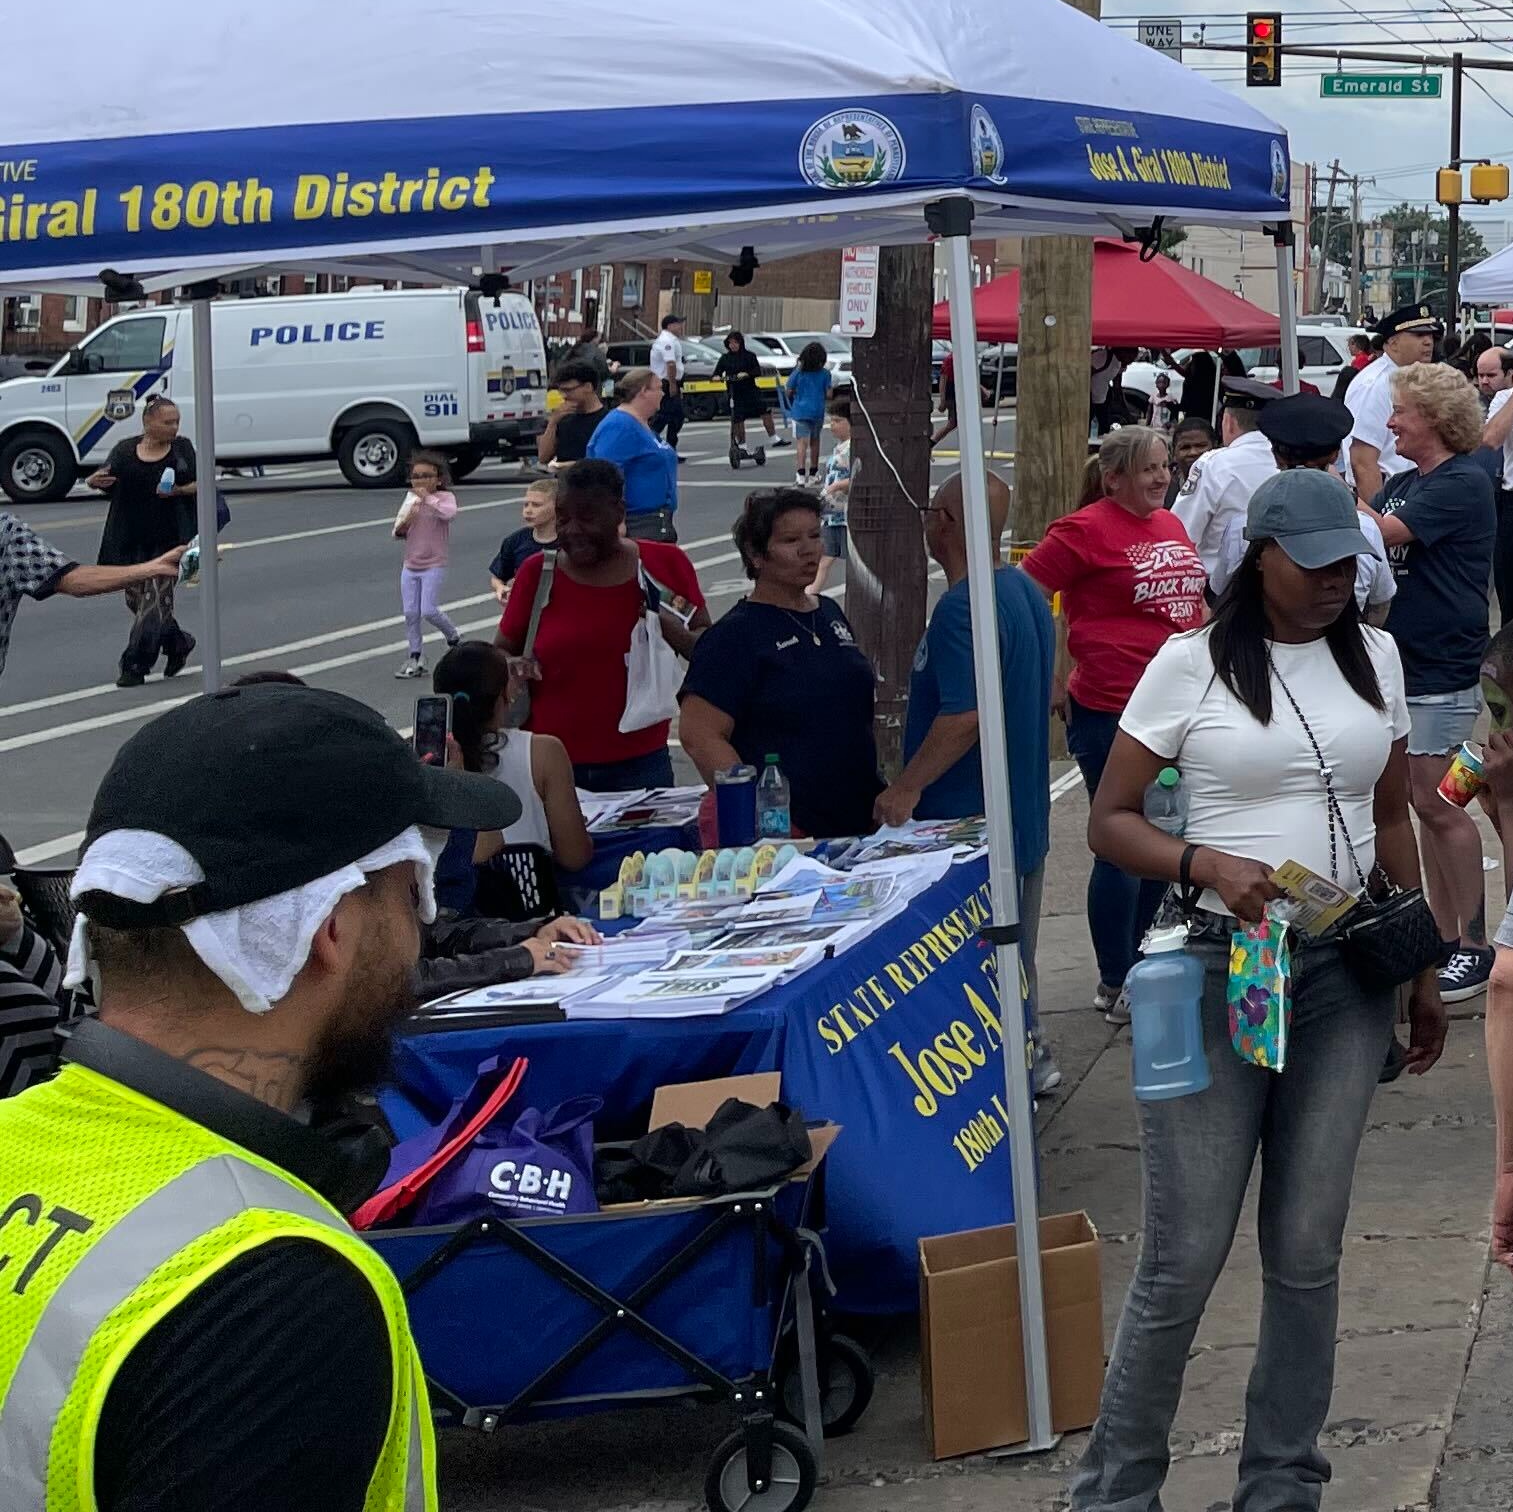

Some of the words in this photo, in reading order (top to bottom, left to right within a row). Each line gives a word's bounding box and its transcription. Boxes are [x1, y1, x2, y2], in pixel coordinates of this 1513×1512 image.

[1146, 25, 1173, 36] ONE
[1146, 37, 1174, 47] WAY
[1332, 79, 1402, 92] Emerald
[1411, 79, 1430, 93] St
[1086, 143, 1122, 181] Jose
[1116, 145, 1138, 182] A.
[1131, 146, 1165, 184] Giral
[1160, 149, 1196, 186] 180th
[1191, 152, 1231, 190] District
[119, 178, 272, 232] 180th
[293, 166, 496, 221] District
[847, 299, 869, 312] ONLY
[485, 311, 538, 331] POLICE
[249, 320, 385, 346] POLICE
[424, 393, 457, 404] DIAL
[424, 403, 458, 417] 911
[1132, 577, 1180, 604] BLOCK
[1168, 601, 1194, 618] 250
[817, 975, 896, 1056] STATE
[884, 878, 994, 996] REPRESENT
[887, 1020, 986, 1117] Jose
[952, 1108, 1005, 1174] 180th
